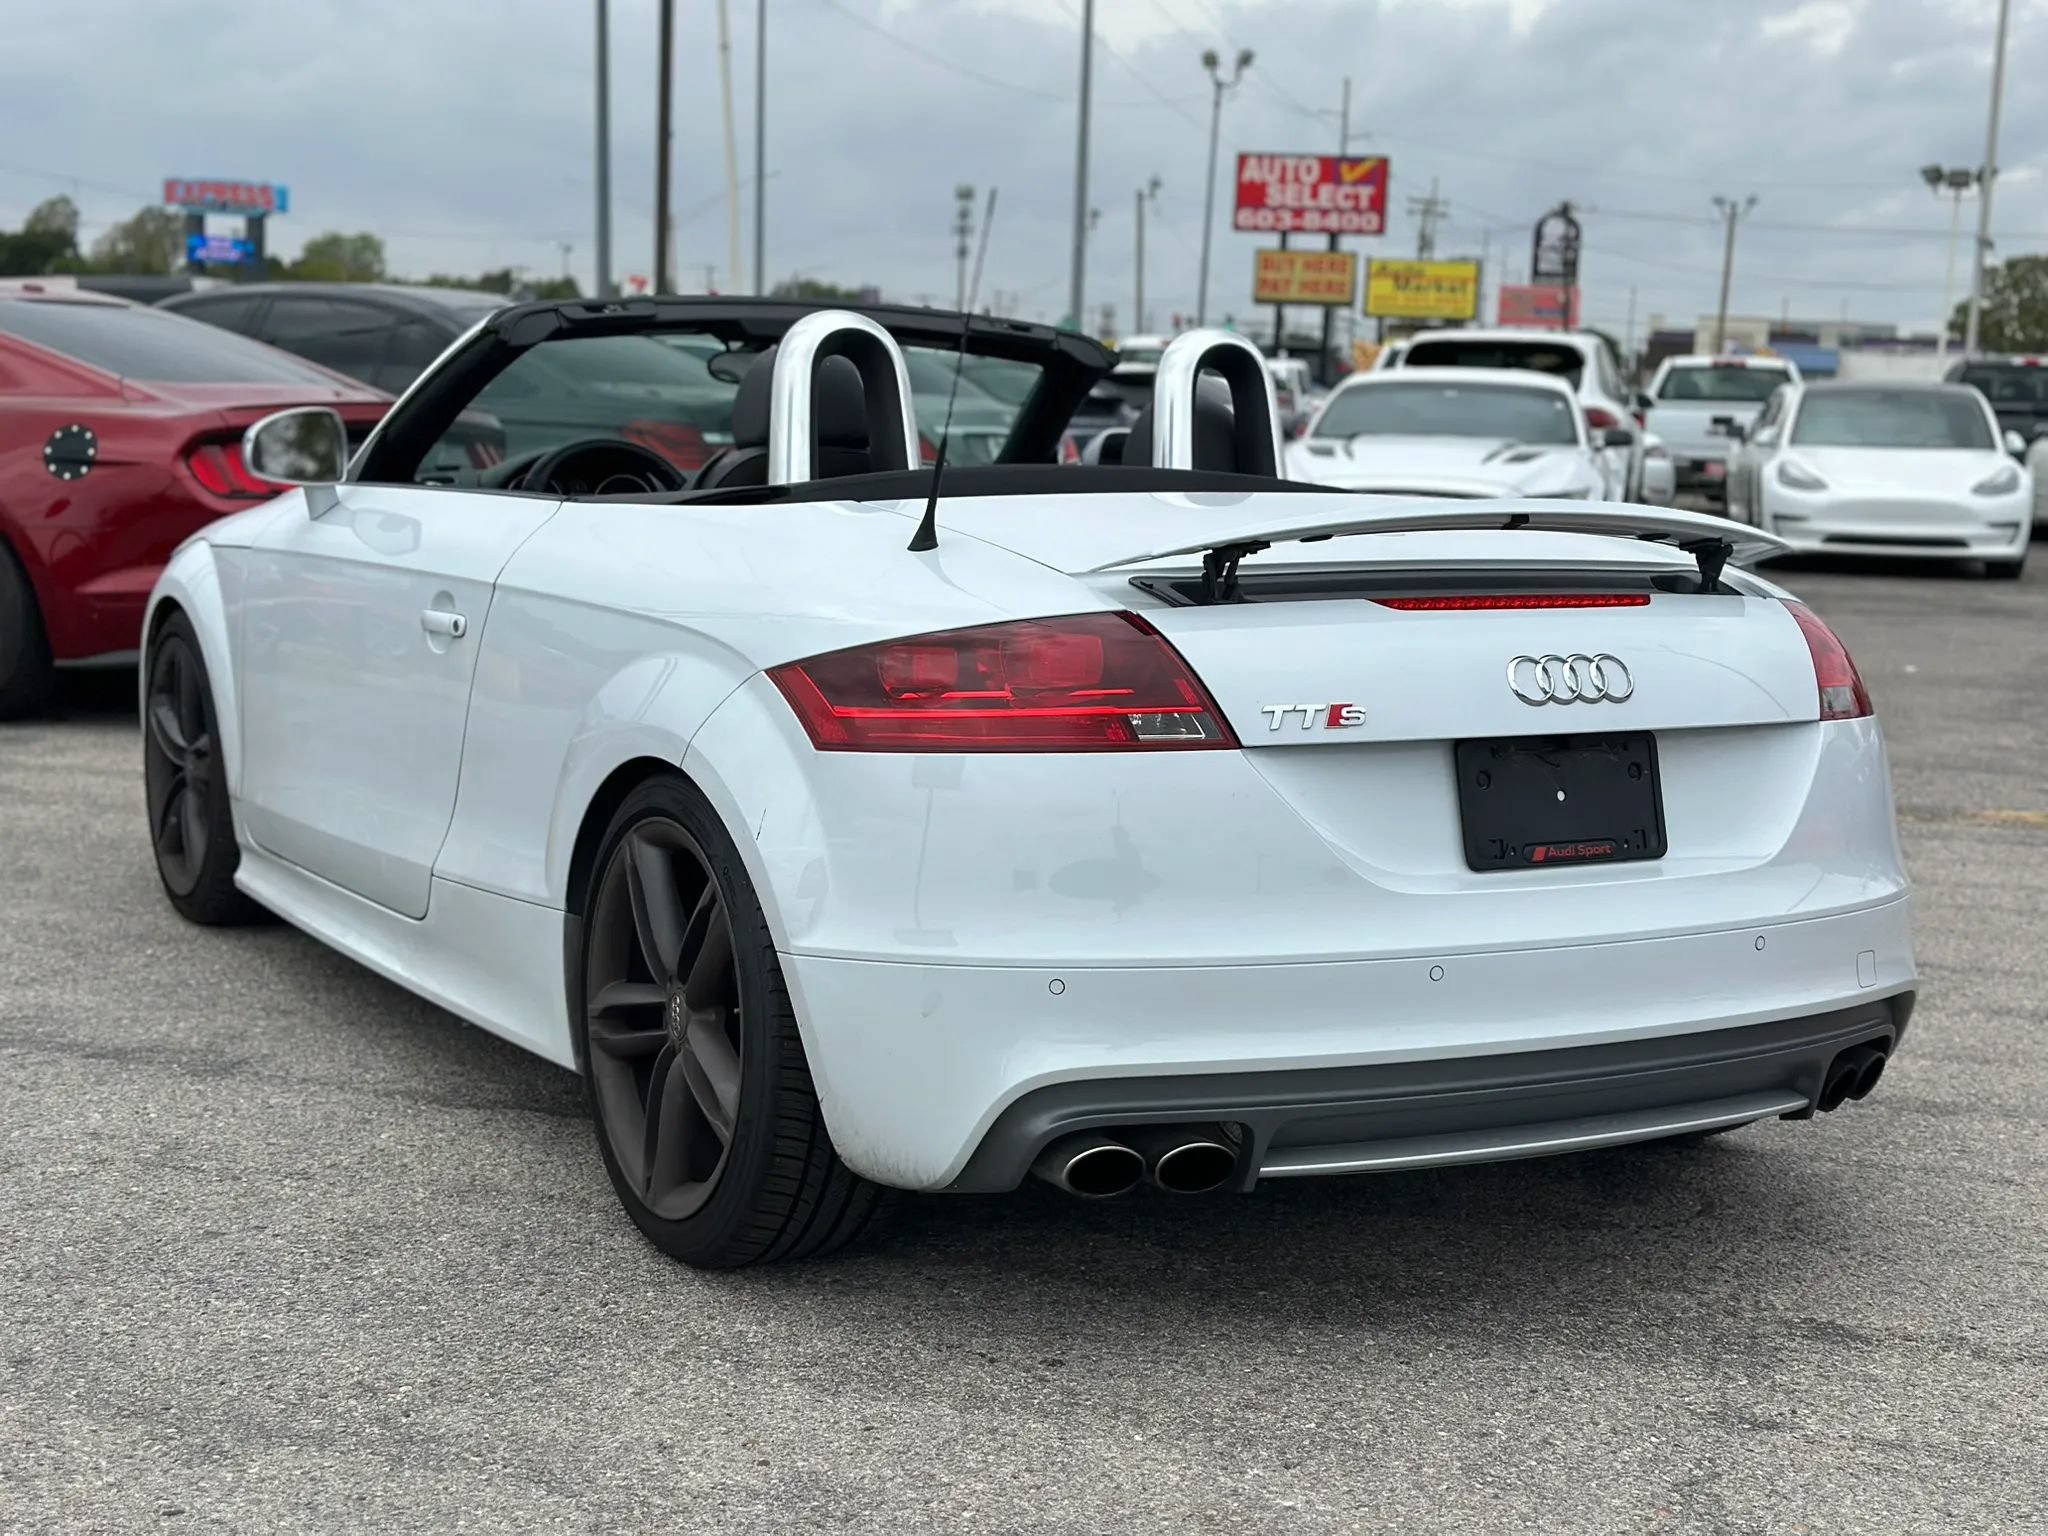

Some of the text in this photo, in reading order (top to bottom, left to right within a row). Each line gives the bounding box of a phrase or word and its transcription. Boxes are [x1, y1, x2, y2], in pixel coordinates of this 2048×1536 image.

[1241, 156, 1320, 183] AUTO
[1264, 182, 1376, 209] SELECT
[1261, 256, 1348, 274] BUY HERE
[1258, 277, 1345, 295] PAY HERE
[1261, 702, 1366, 731] TTS
[1549, 844, 1612, 858] Audi Sport
